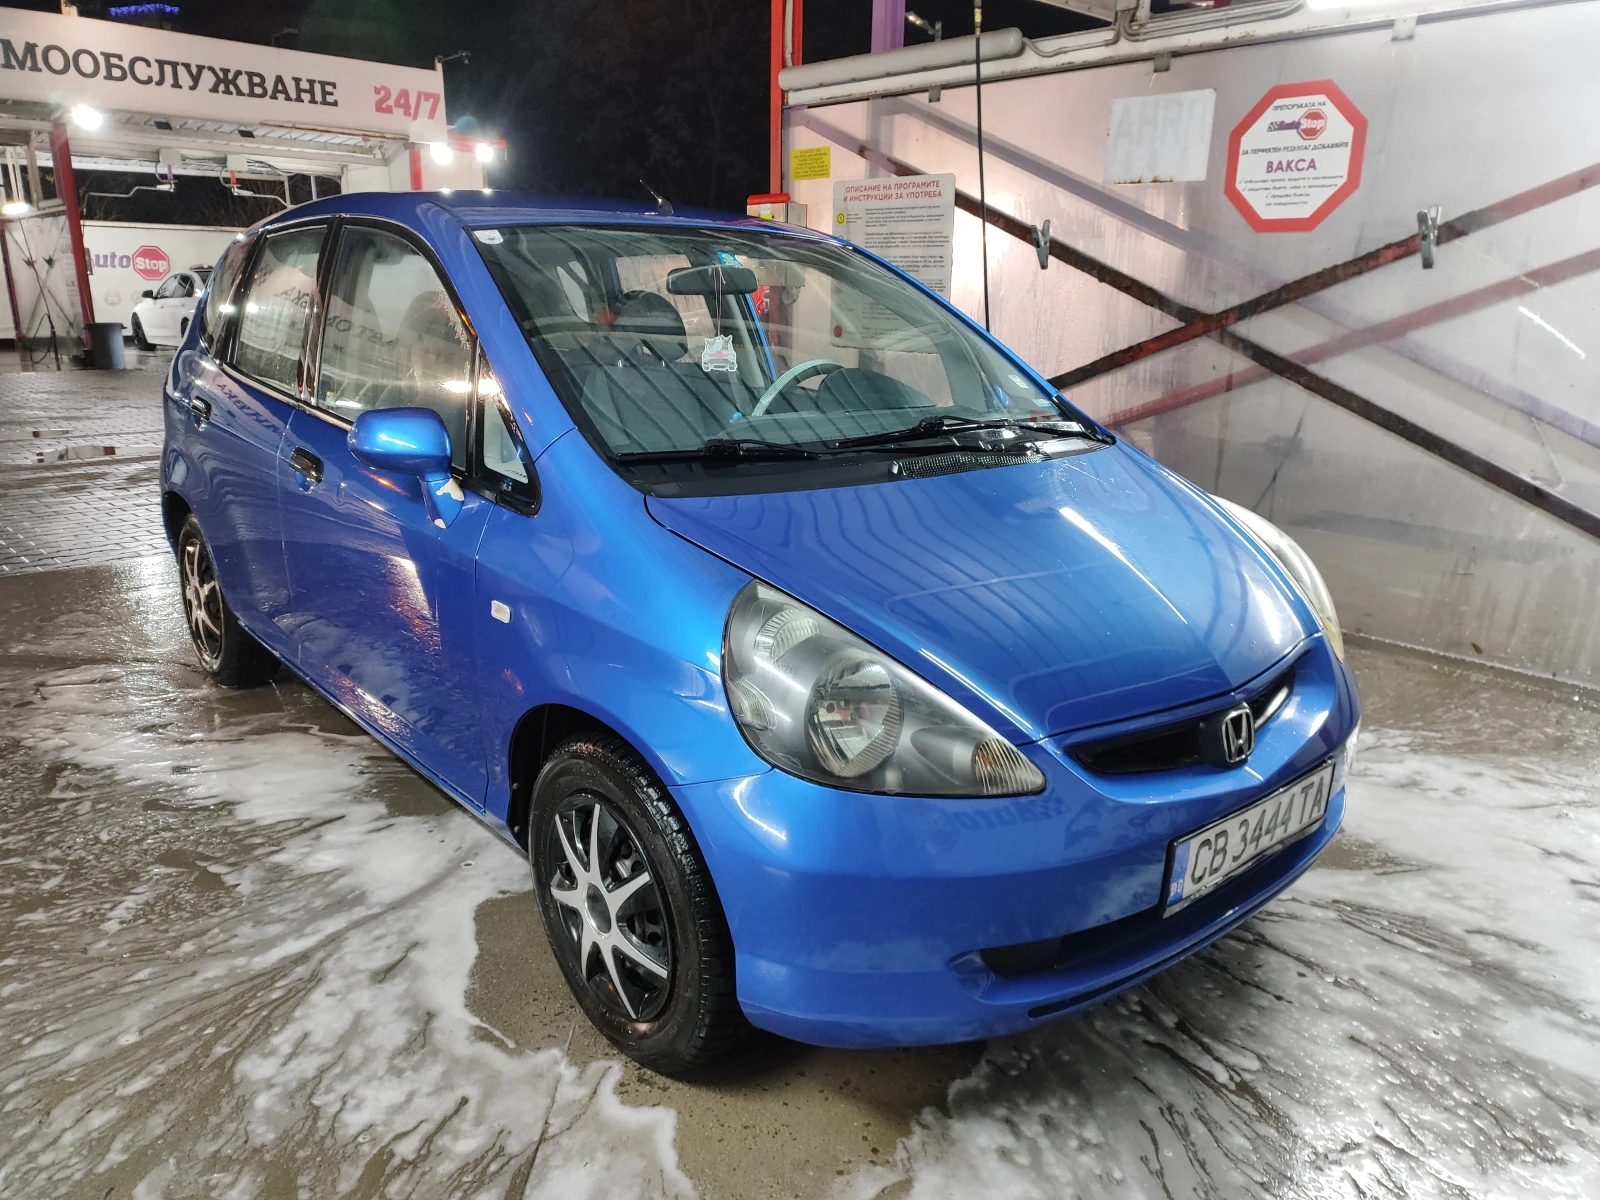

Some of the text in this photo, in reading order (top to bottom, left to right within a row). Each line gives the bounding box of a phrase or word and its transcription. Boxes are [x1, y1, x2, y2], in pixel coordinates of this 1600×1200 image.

[374, 85, 441, 121] 24/7
[1266, 158, 1318, 174] ВАКСА
[845, 180, 940, 194] ОПИСАНИЕ НА ПРОГРАМИТЕ
[849, 193, 893, 202] ИНСТРУКЦИИ
[894, 192, 904, 200] ЗА
[905, 190, 943, 200] УПОТРЕБА
[92, 252, 168, 273] uto Stop
[1190, 776, 1324, 885] CB 3444 TA
[1170, 879, 1184, 897] BG
